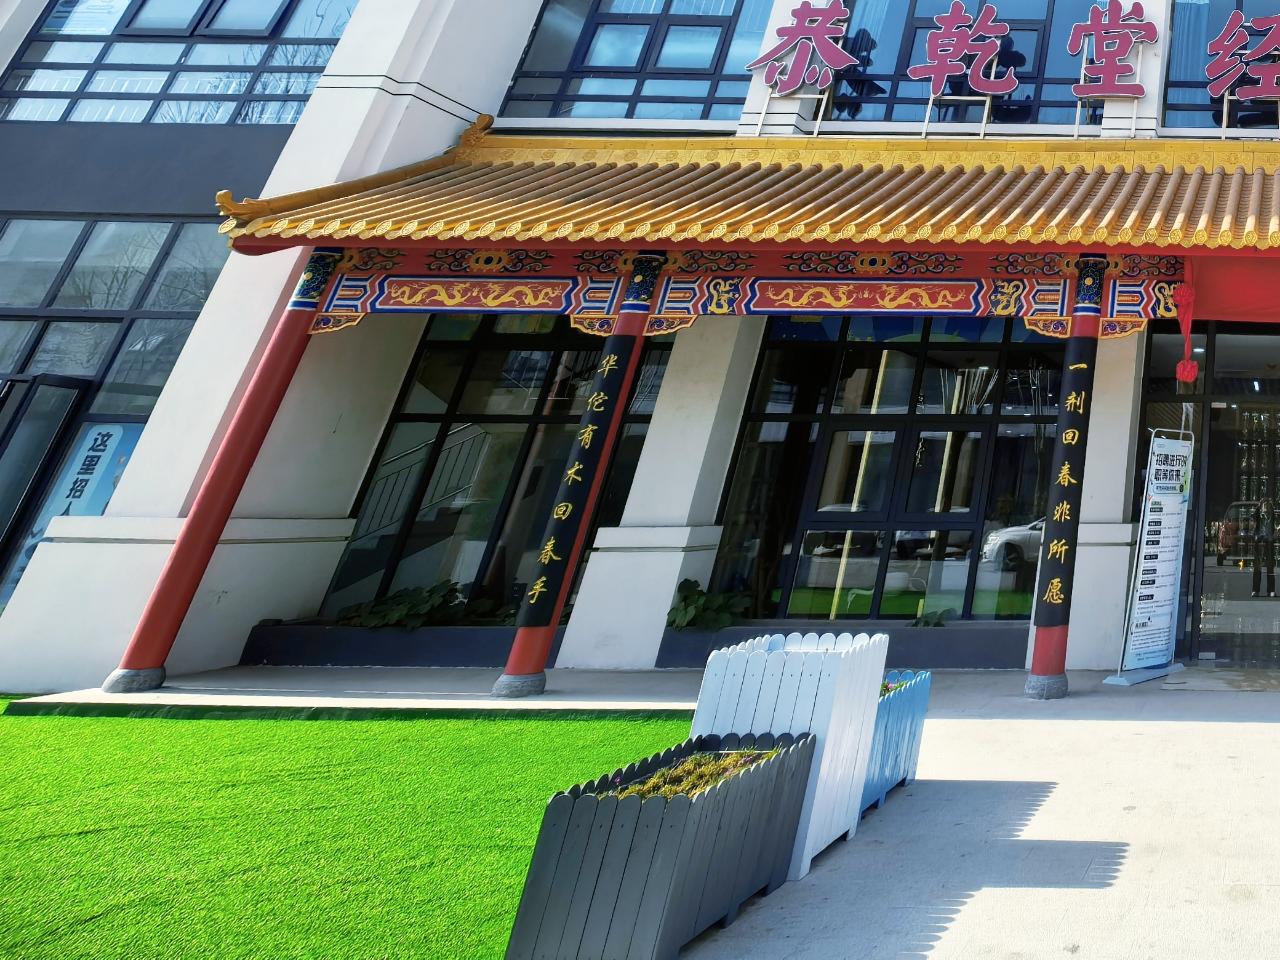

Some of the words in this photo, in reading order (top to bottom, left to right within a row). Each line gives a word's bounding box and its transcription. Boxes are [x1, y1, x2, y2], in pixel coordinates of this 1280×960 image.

[527, 353, 619, 605] 华佗有术回春手
[1042, 362, 1089, 606] 一剂回春非所愿
